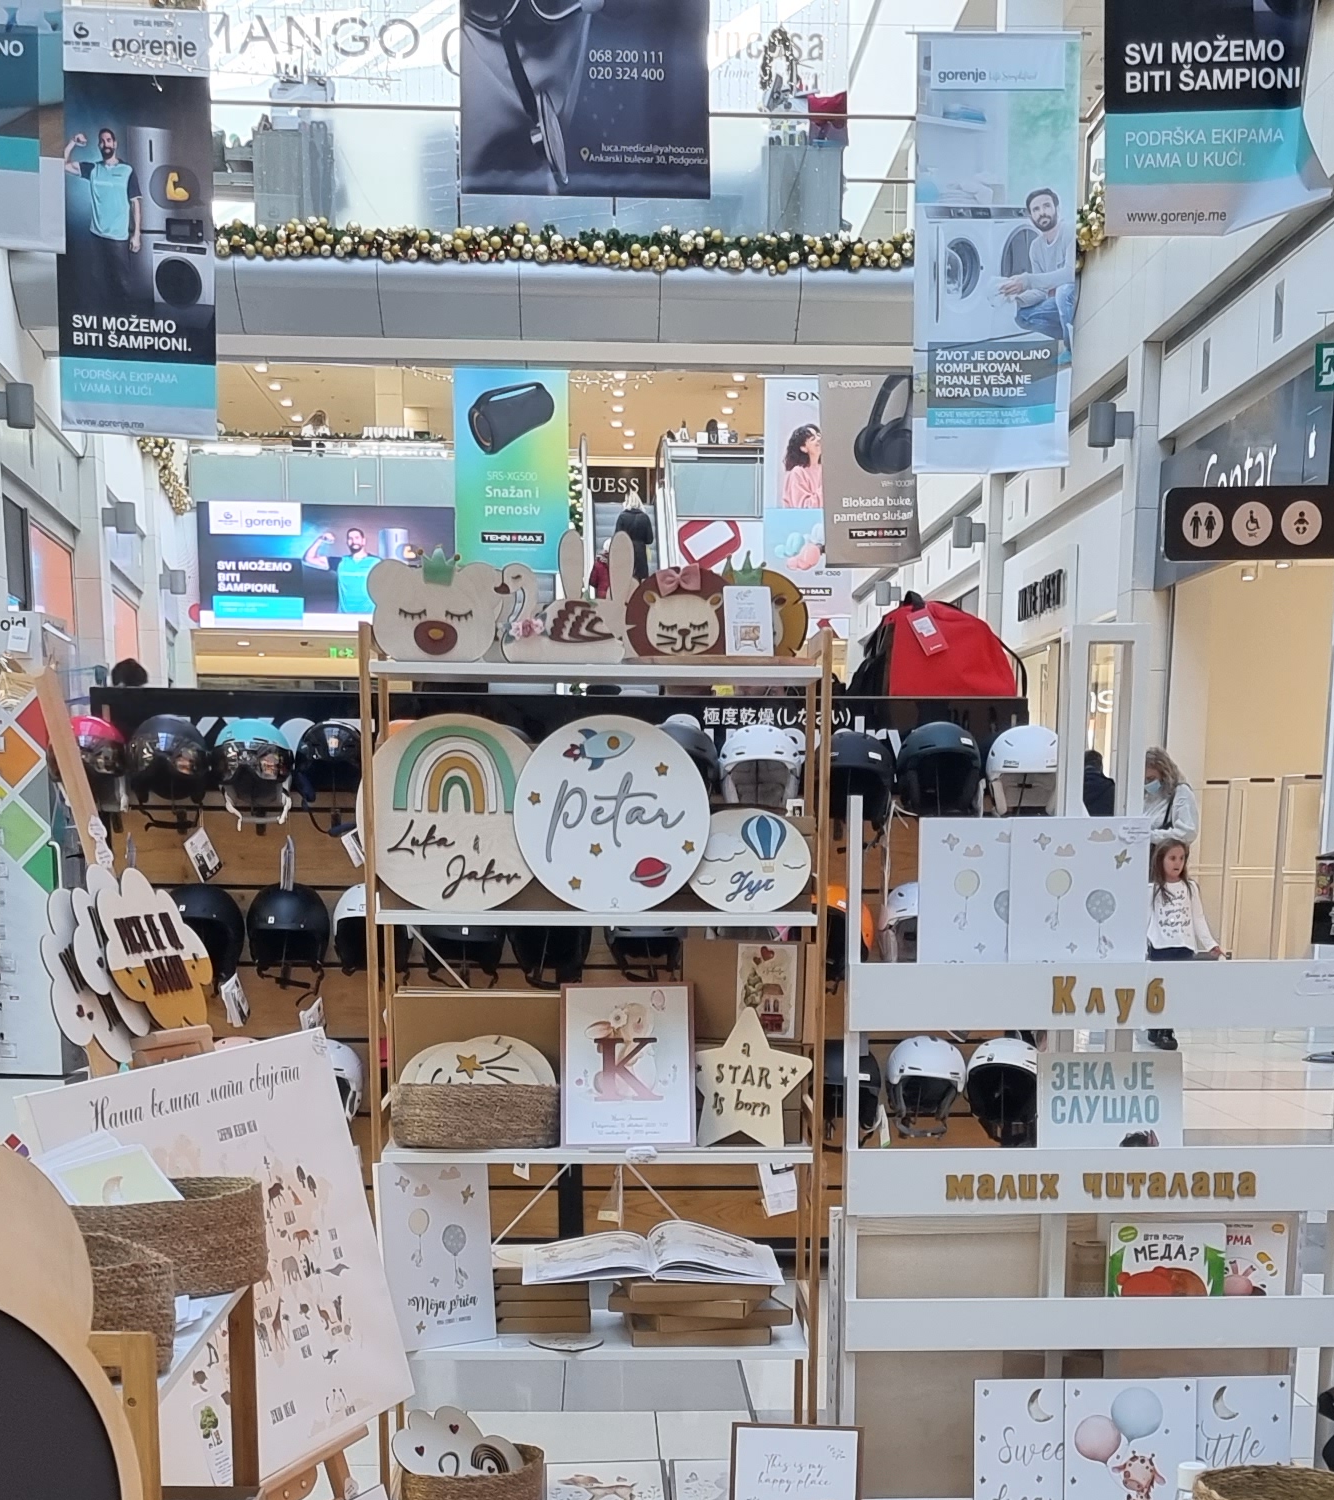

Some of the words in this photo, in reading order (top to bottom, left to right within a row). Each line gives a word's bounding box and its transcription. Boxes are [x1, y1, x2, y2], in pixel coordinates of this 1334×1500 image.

[112, 35, 197, 62] gorenje
[589, 49, 612, 63] 068
[615, 50, 639, 63] 200
[642, 51, 664, 64] 111
[1124, 42, 1163, 66] SVI
[1171, 34, 1285, 64] MOŽEMO
[589, 67, 613, 79] 020
[615, 67, 638, 80] 324
[641, 68, 665, 81] 400
[938, 68, 987, 83] gorenje
[1125, 70, 1171, 94] BITI
[1178, 64, 1301, 91] ŠAMPIONI
[1125, 127, 1206, 147] PODRŠKA
[1211, 128, 1285, 145] EKIPAMA
[601, 143, 704, 155] luca.medical@yahoo.com
[589, 153, 622, 164] Ankarski
[624, 154, 654, 164] bulevar
[669, 156, 708, 167] Podgorica
[1125, 153, 1129, 169] I
[1133, 152, 1182, 168] VAMA
[1186, 151, 1198, 168] U
[1203, 147, 1246, 167] KUĆI.
[1127, 209, 1227, 224] www.gorenje.me
[72, 314, 97, 330] SVI
[102, 314, 176, 334] MOŽEMO
[73, 331, 103, 347] BITI
[107, 331, 192, 352] ŠAMPIONI.
[936, 349, 969, 361] ŽIVOT
[971, 350, 985, 361] JE
[987, 349, 1051, 361] DOVOLJNO
[73, 368, 127, 382] PODRŠKA
[129, 371, 178, 384] EKIPAMA
[935, 362, 1023, 374] KOMPLIKOVAN.
[935, 375, 982, 386] PRANJE
[983, 373, 1013, 385] VEŠA
[1015, 374, 1031, 385] NE
[80, 383, 111, 394] VAMA
[114, 384, 122, 395] U
[935, 387, 971, 398] MORA
[973, 387, 989, 397] DA
[486, 471, 538, 481] SRS-XG500
[485, 485, 532, 499] Snažan
[534, 486, 540, 499] i
[484, 504, 541, 517] prenosiv
[842, 497, 885, 508] Blokada
[245, 516, 292, 534] gorenje
[833, 511, 880, 524] pametno
[217, 560, 240, 572] SVI
[242, 559, 292, 573] MOŽEMO
[217, 572, 241, 583] BITI
[703, 706, 852, 726] 極度乾燥(しない)
[387, 818, 455, 859] Luka
[441, 854, 522, 899] Jakov
[1051, 976, 1165, 1024] Клуб
[741, 1042, 751, 1058] a
[593, 1037, 664, 1102] K
[715, 1063, 772, 1090] STAR
[1051, 1060, 1116, 1090] ЗЕКА
[1123, 1060, 1155, 1090] ЈЕ
[734, 1089, 771, 1117] born
[1051, 1094, 1160, 1125] СЛУШАО
[89, 1096, 145, 1133] Наша
[1133, 1243, 1200, 1263] МЕДА?
[758, 1471, 793, 1493] happy
[796, 1472, 831, 1492] place
